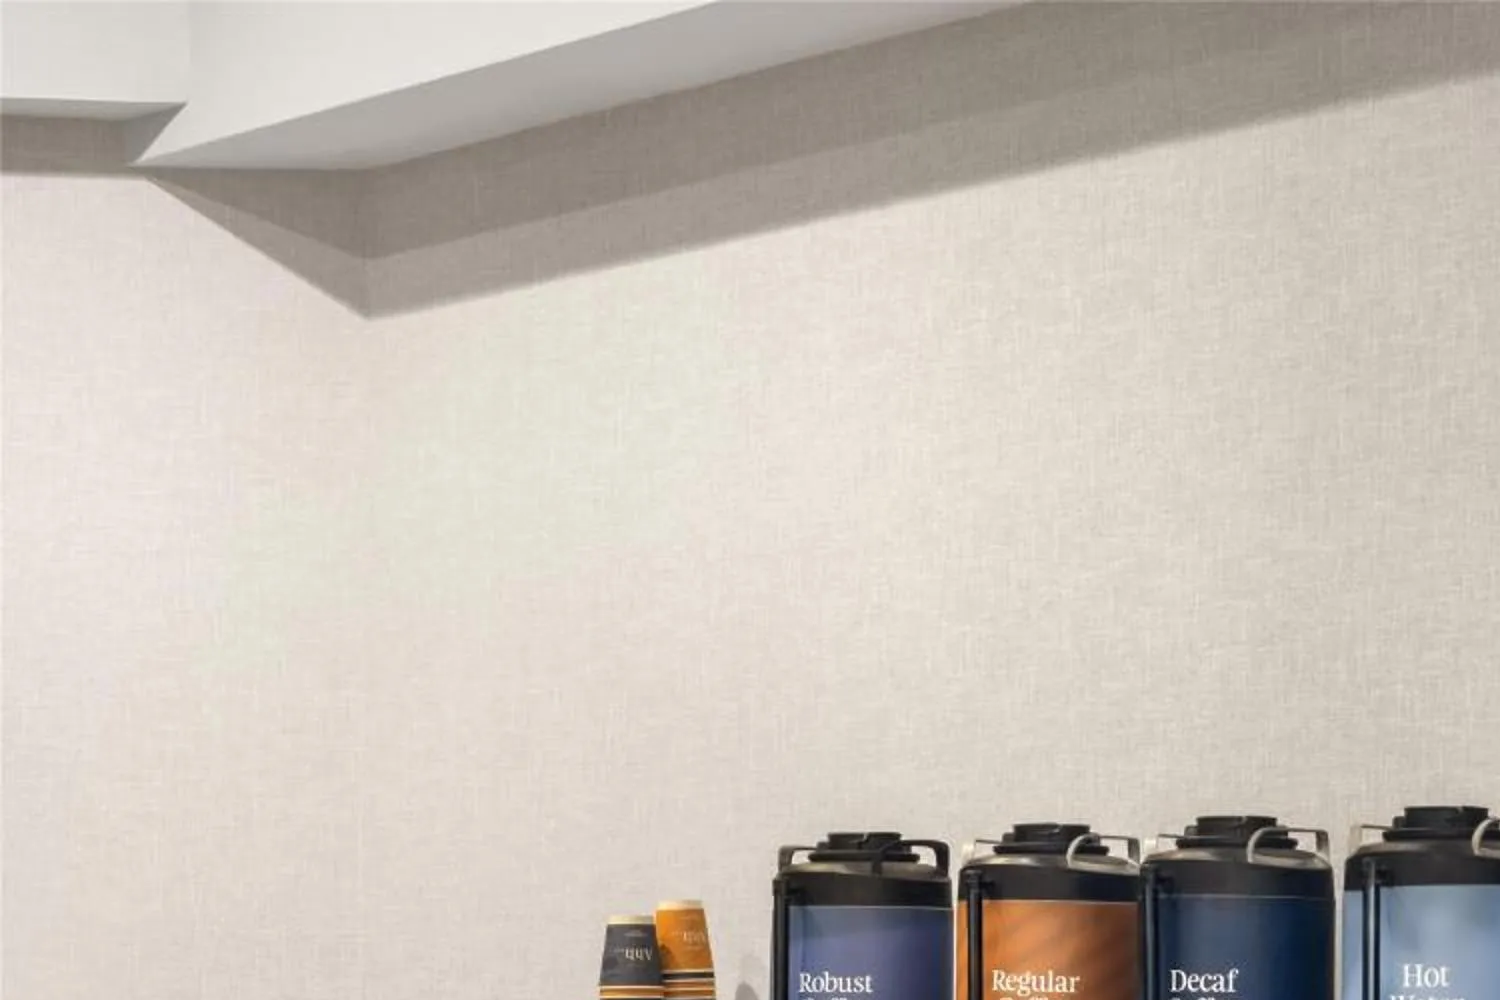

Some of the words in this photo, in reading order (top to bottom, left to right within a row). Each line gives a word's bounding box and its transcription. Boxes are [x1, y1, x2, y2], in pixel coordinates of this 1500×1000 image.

[799, 972, 873, 993] Robust
[992, 969, 1080, 997] Regular
[1170, 968, 1239, 994] Decaf
[1402, 963, 1450, 988] Hot
